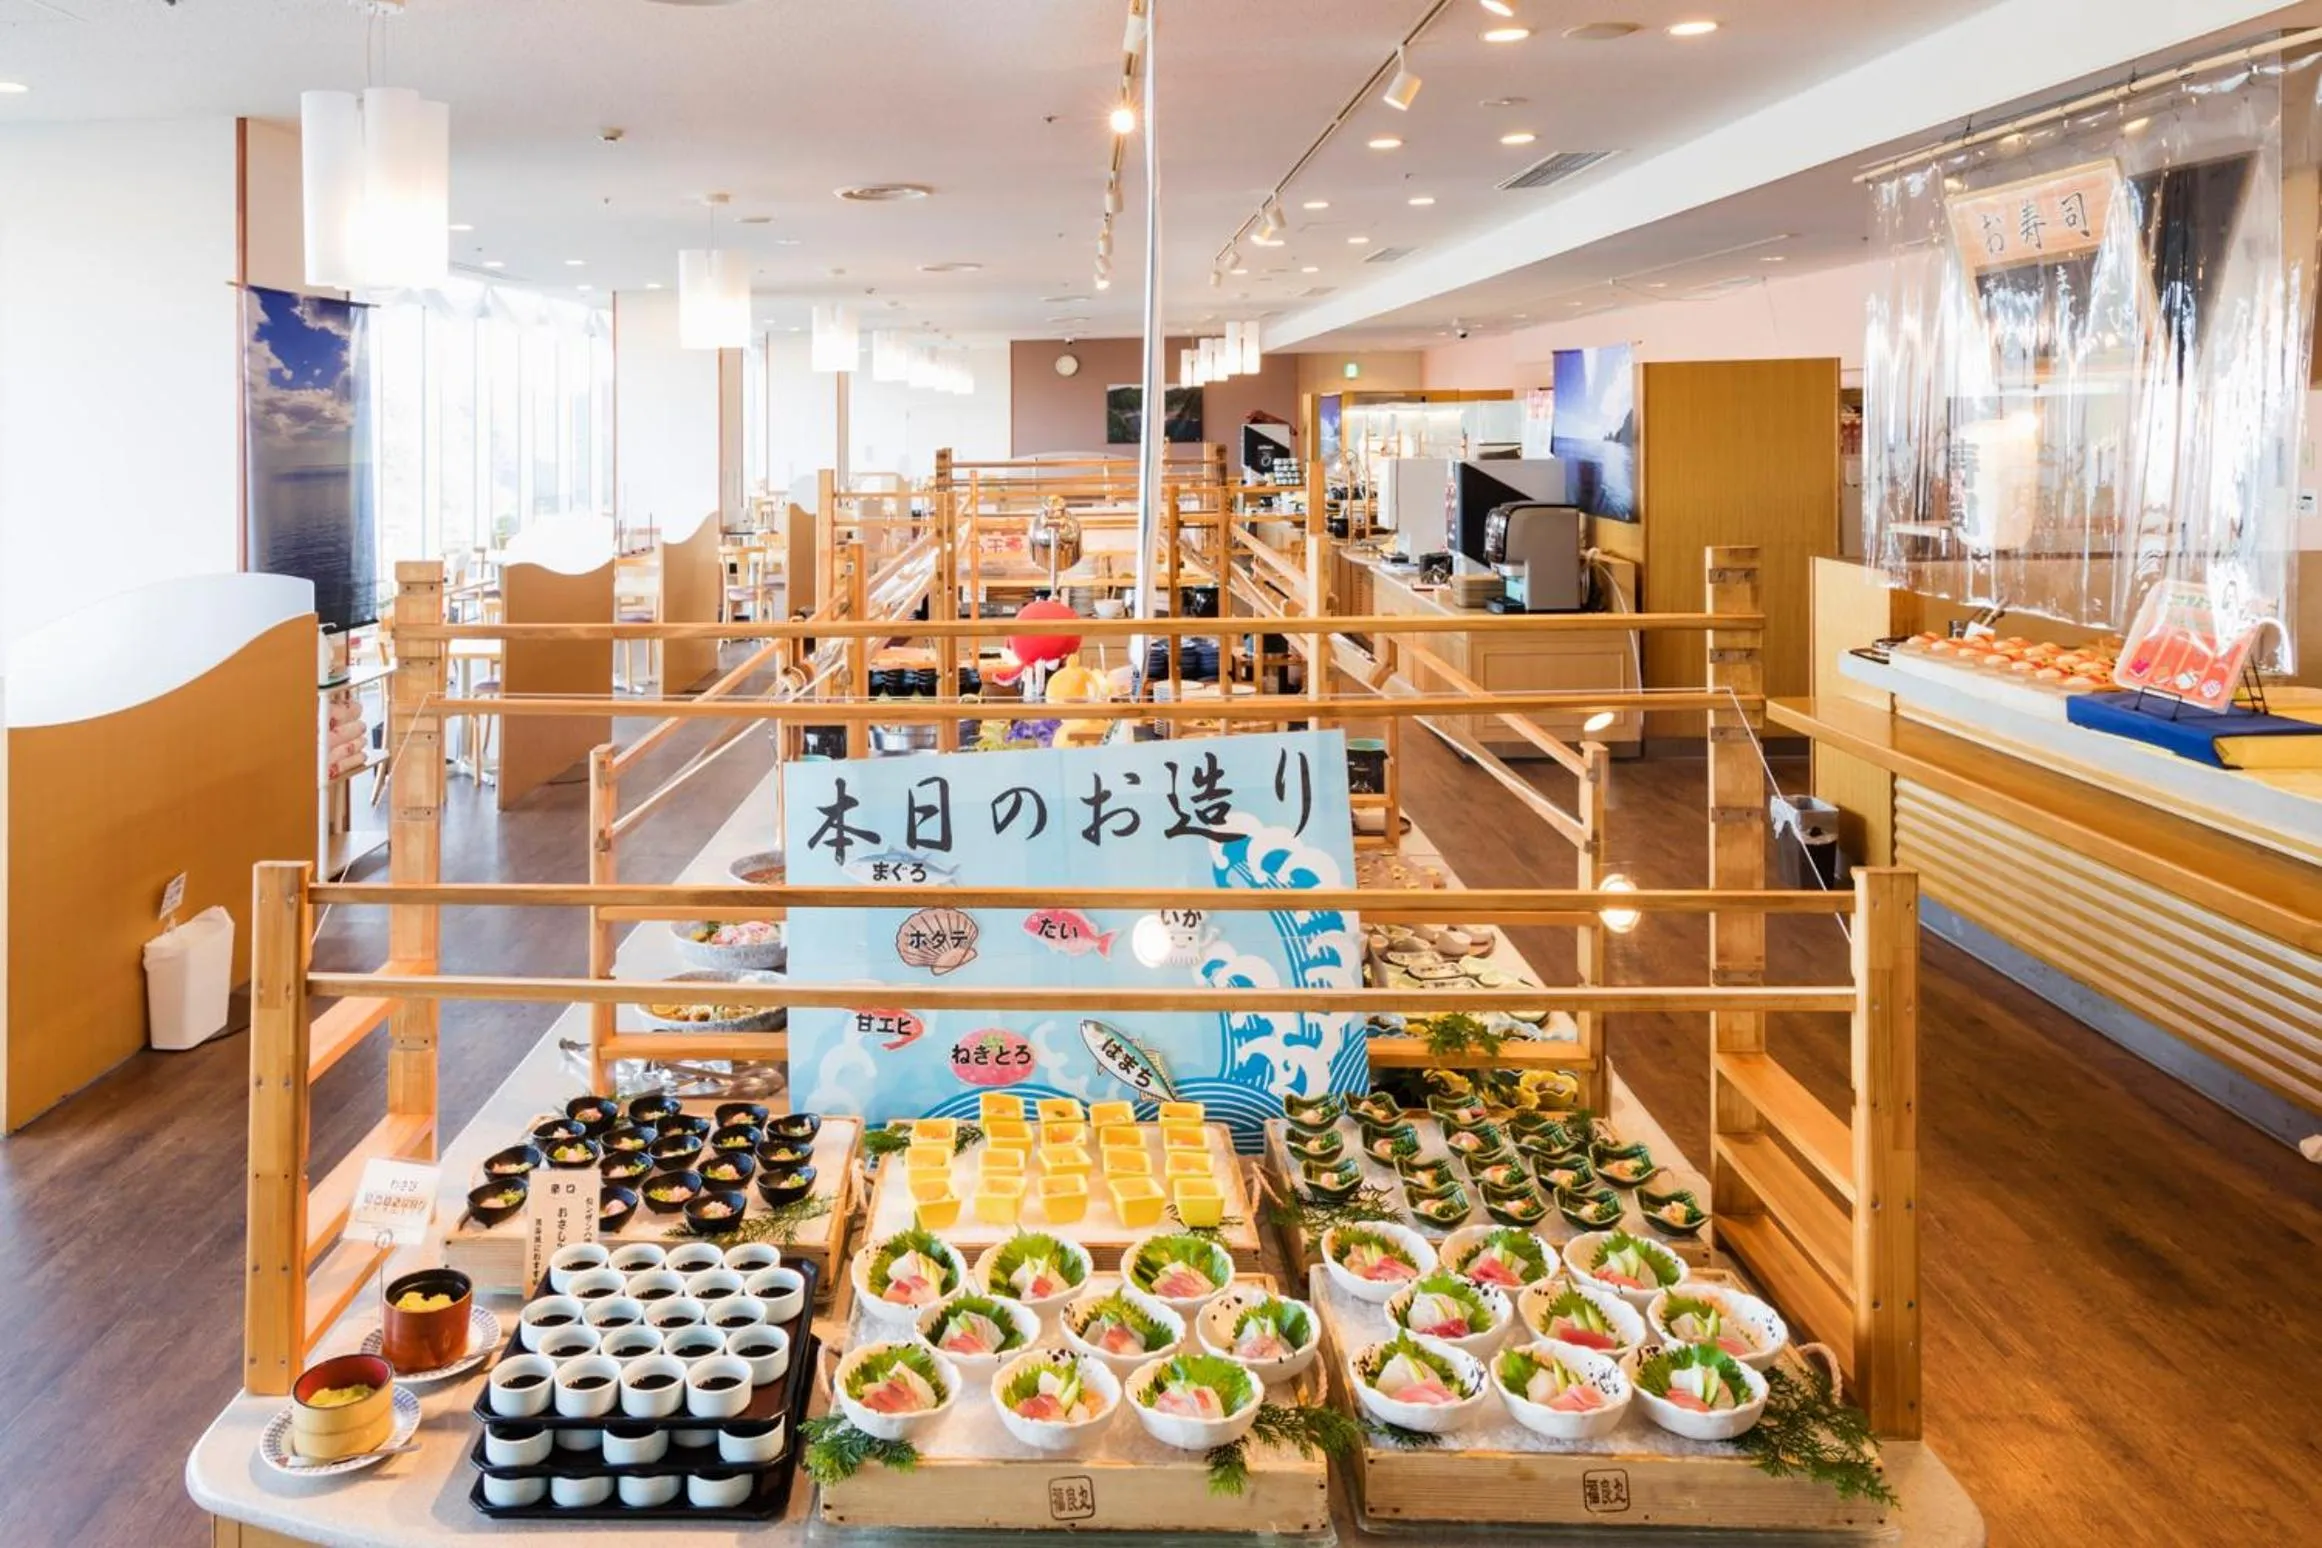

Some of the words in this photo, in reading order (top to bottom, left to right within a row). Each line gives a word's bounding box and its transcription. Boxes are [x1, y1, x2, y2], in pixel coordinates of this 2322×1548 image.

[1981, 191, 2090, 255] お寿司
[807, 746, 1313, 867] 本日のお造り
[872, 861, 927, 883] まぐろ
[1037, 917, 1079, 940] たい
[1160, 909, 1202, 928] いか
[908, 930, 968, 949] ホタテ
[856, 1013, 915, 1036] 甘エビ
[1101, 1037, 1153, 1088] はまち
